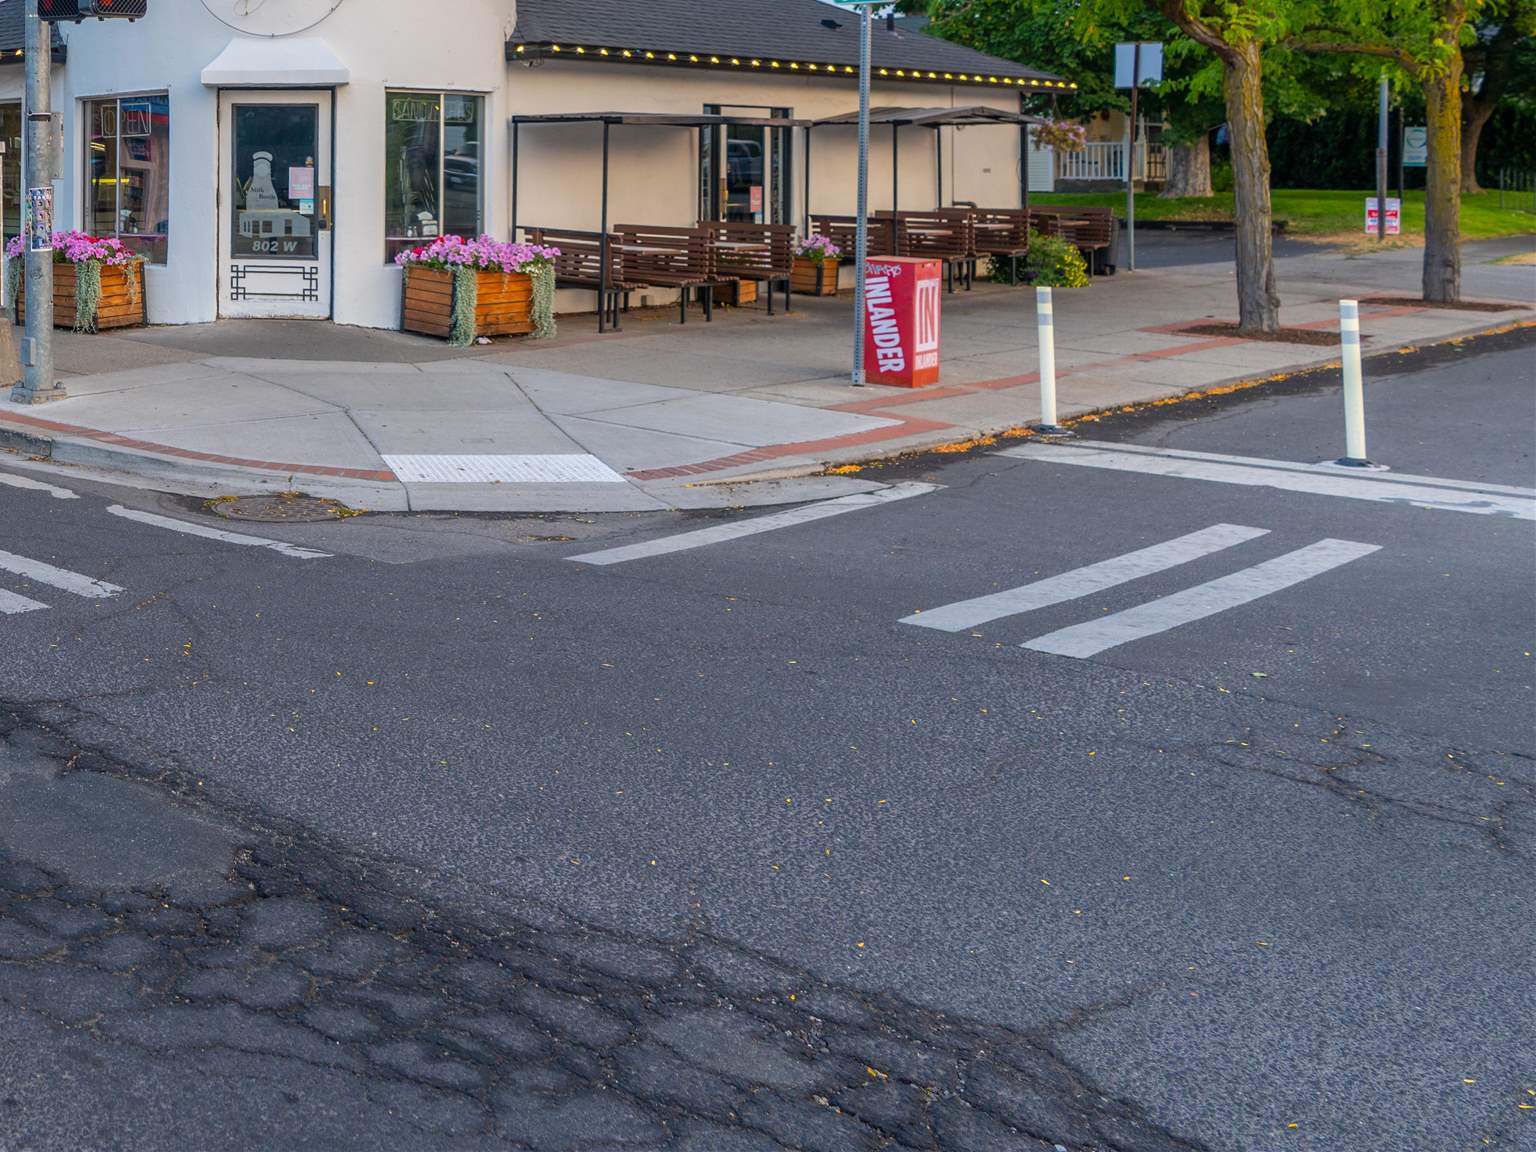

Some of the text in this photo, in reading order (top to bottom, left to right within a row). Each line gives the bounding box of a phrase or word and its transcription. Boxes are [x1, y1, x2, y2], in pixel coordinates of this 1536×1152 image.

[252, 240, 298, 252] 802 W
[864, 276, 905, 373] INLANDER
